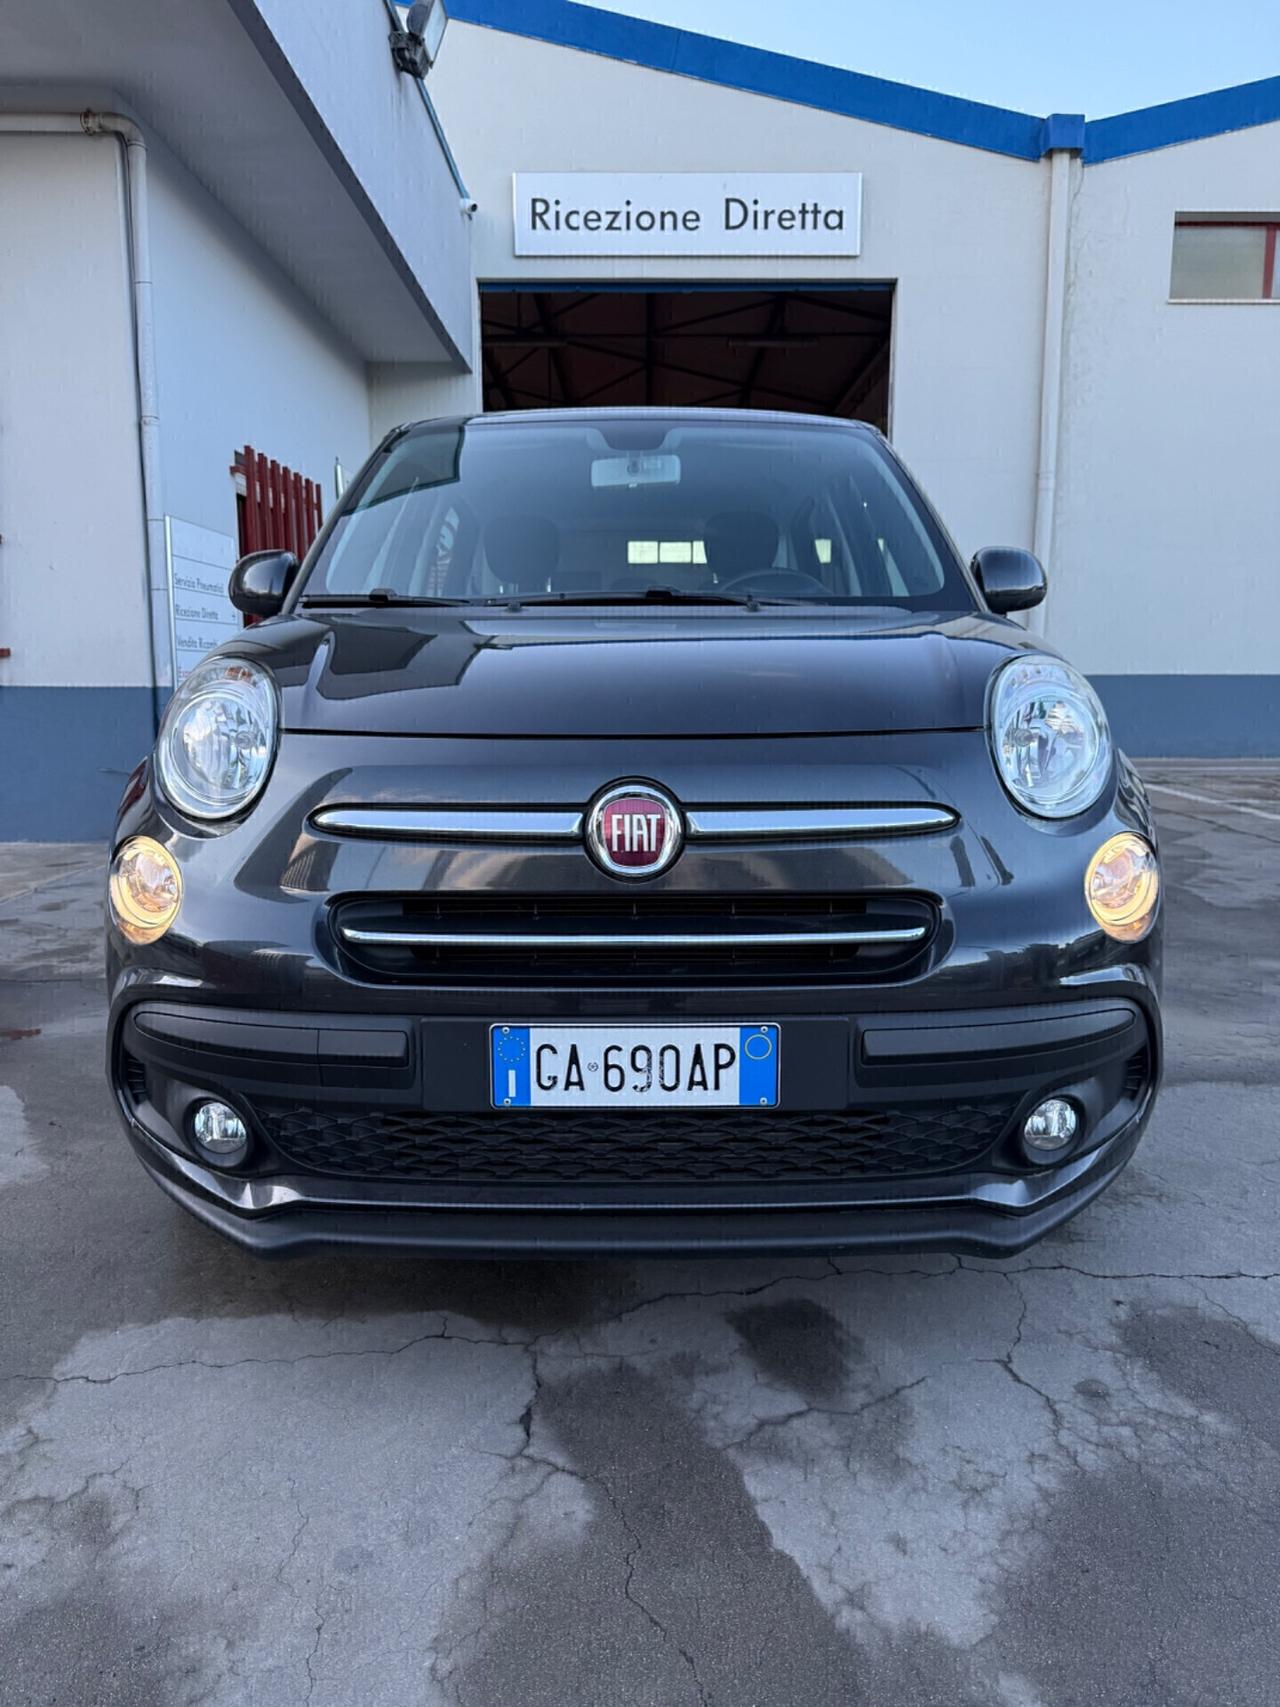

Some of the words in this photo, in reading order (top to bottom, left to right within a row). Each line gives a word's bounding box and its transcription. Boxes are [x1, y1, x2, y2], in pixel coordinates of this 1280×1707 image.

[530, 197, 701, 231] Ricezione
[724, 197, 845, 231] Diretta
[611, 814, 660, 852] FIAT
